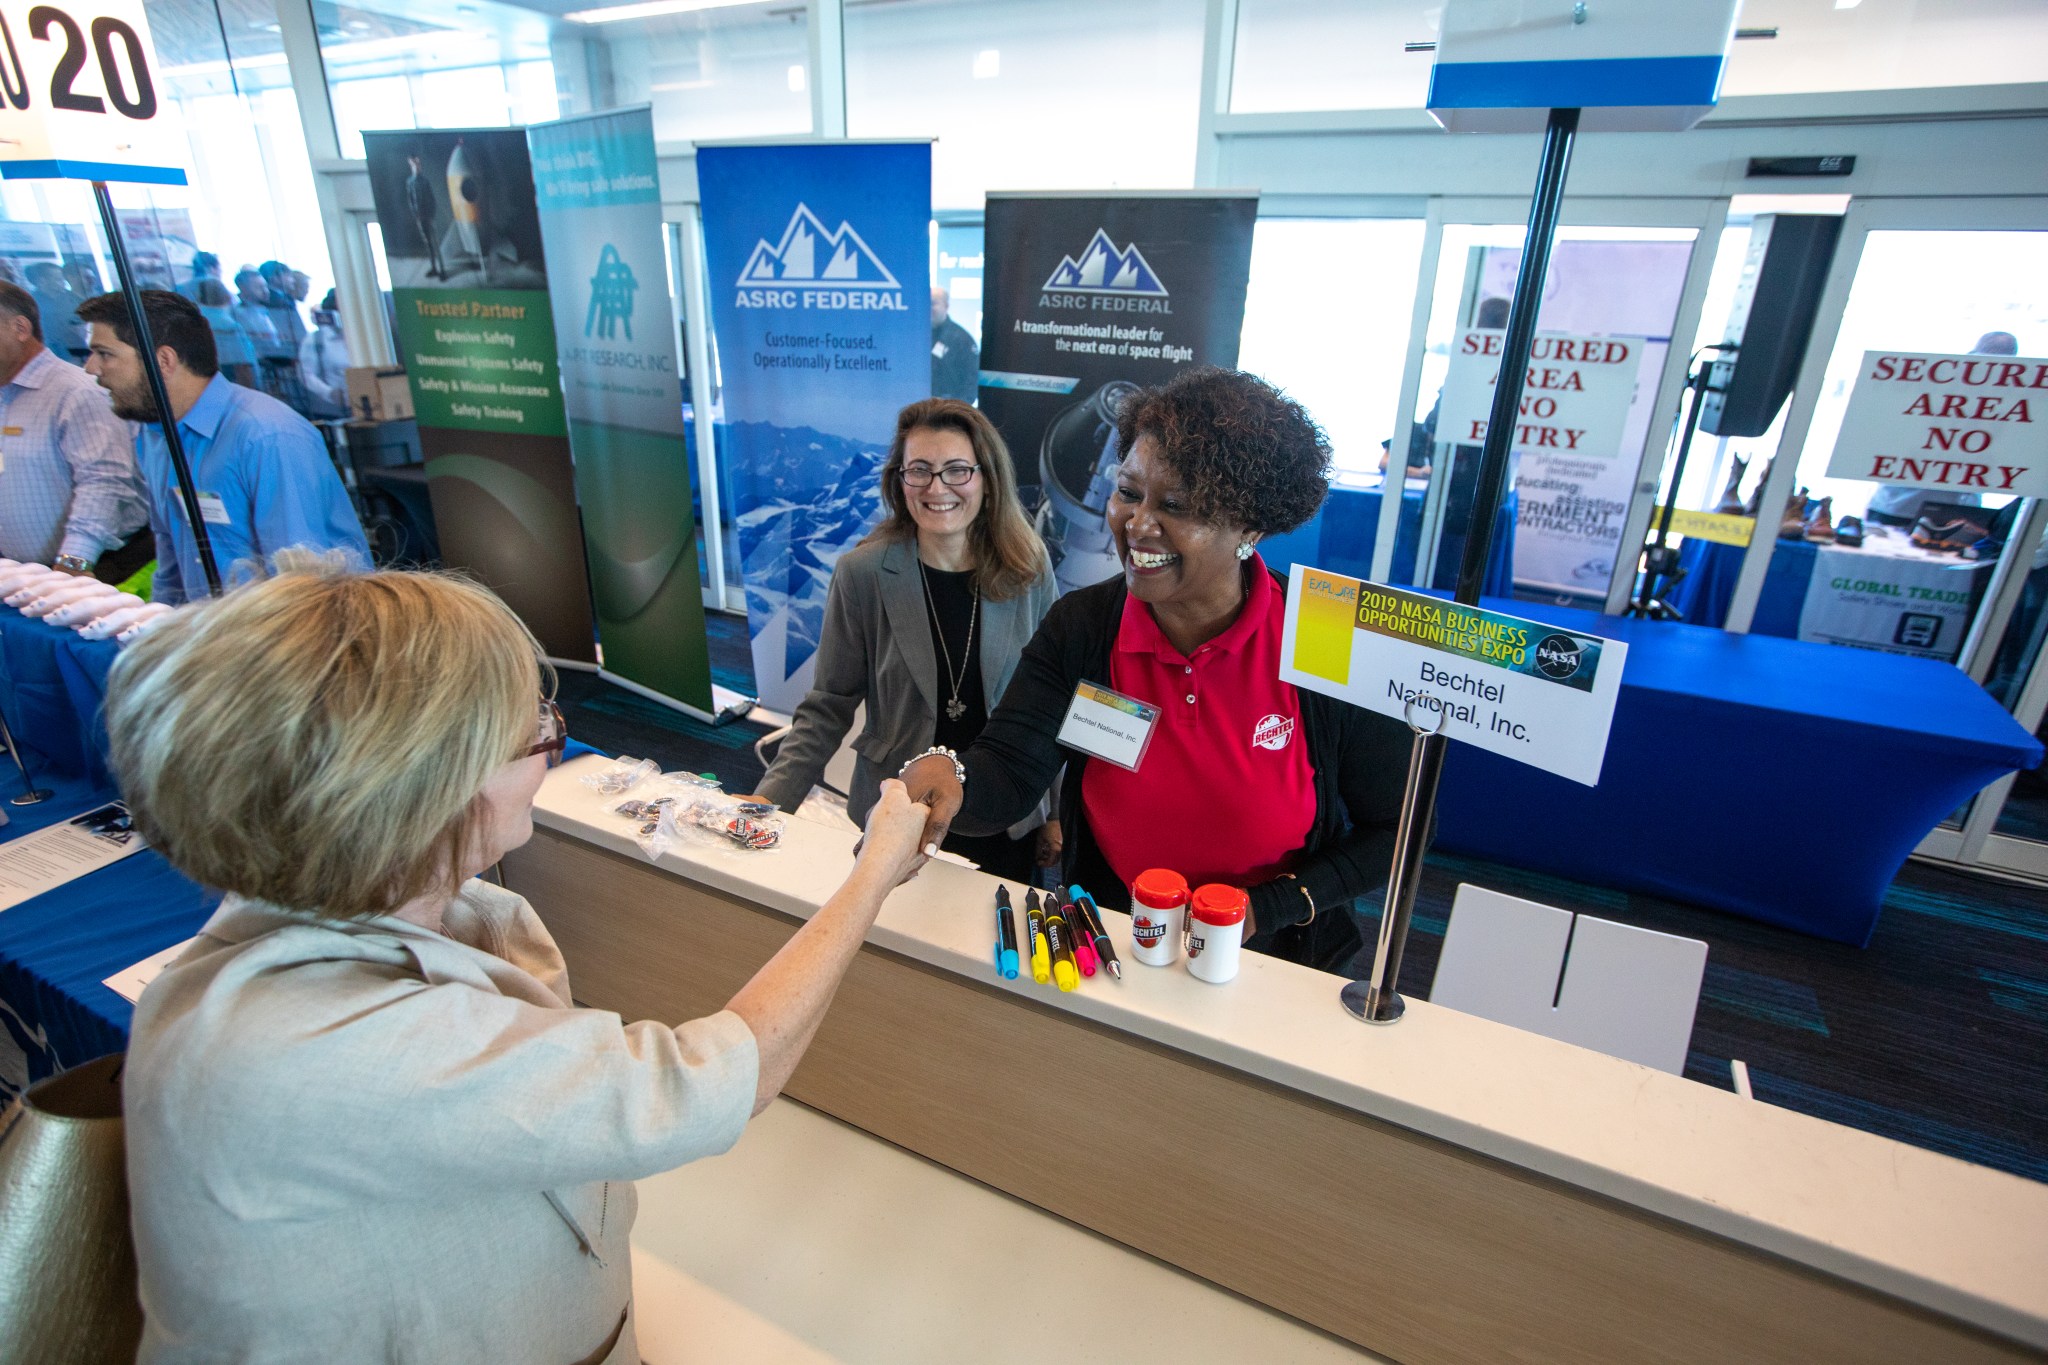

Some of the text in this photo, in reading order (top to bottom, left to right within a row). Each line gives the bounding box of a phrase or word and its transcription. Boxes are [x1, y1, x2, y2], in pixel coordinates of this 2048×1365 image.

[28, 5, 157, 120] 20
[416, 300, 525, 319] Trusted Partner
[735, 290, 909, 311] ASRC FEDERAL
[1039, 294, 1173, 314] ASRC FEDERAL
[435, 329, 515, 348] Explosive Safety
[765, 331, 877, 350] Customer-Focused.
[1014, 319, 1163, 342] A transformational leader for
[1055, 337, 1193, 363] the next era of space flight
[1462, 334, 1629, 365] SEURED
[511, 358, 544, 375] Safety
[753, 352, 892, 373] Operationally Excellent.
[418, 377, 449, 394] Safety
[460, 380, 498, 394] Mission
[500, 382, 549, 397] Assurance
[451, 402, 523, 423] Safety Training
[1902, 393, 2033, 423] AREA
[1469, 420, 1587, 450] ETRY
[1921, 427, 1992, 453] NO
[1867, 455, 2030, 489] ENTRY
[1517, 500, 1612, 524] ERNMENT
[1556, 494, 1625, 516] assisting
[1517, 516, 1620, 540] NTRACTORS
[1831, 577, 1902, 596] GLOBAL
[1361, 590, 1528, 648] 2019 NASA BUSINESS
[1358, 607, 1527, 666] OPPORTUNITIES EXPO
[1538, 647, 1578, 667] NASA
[1388, 661, 1531, 743] Bechtel National, Inc.
[1072, 712, 1137, 744] Bechtel National, Inc.
[1255, 720, 1292, 745] BECHTEL
[1049, 925, 1061, 952] BECHTEL
